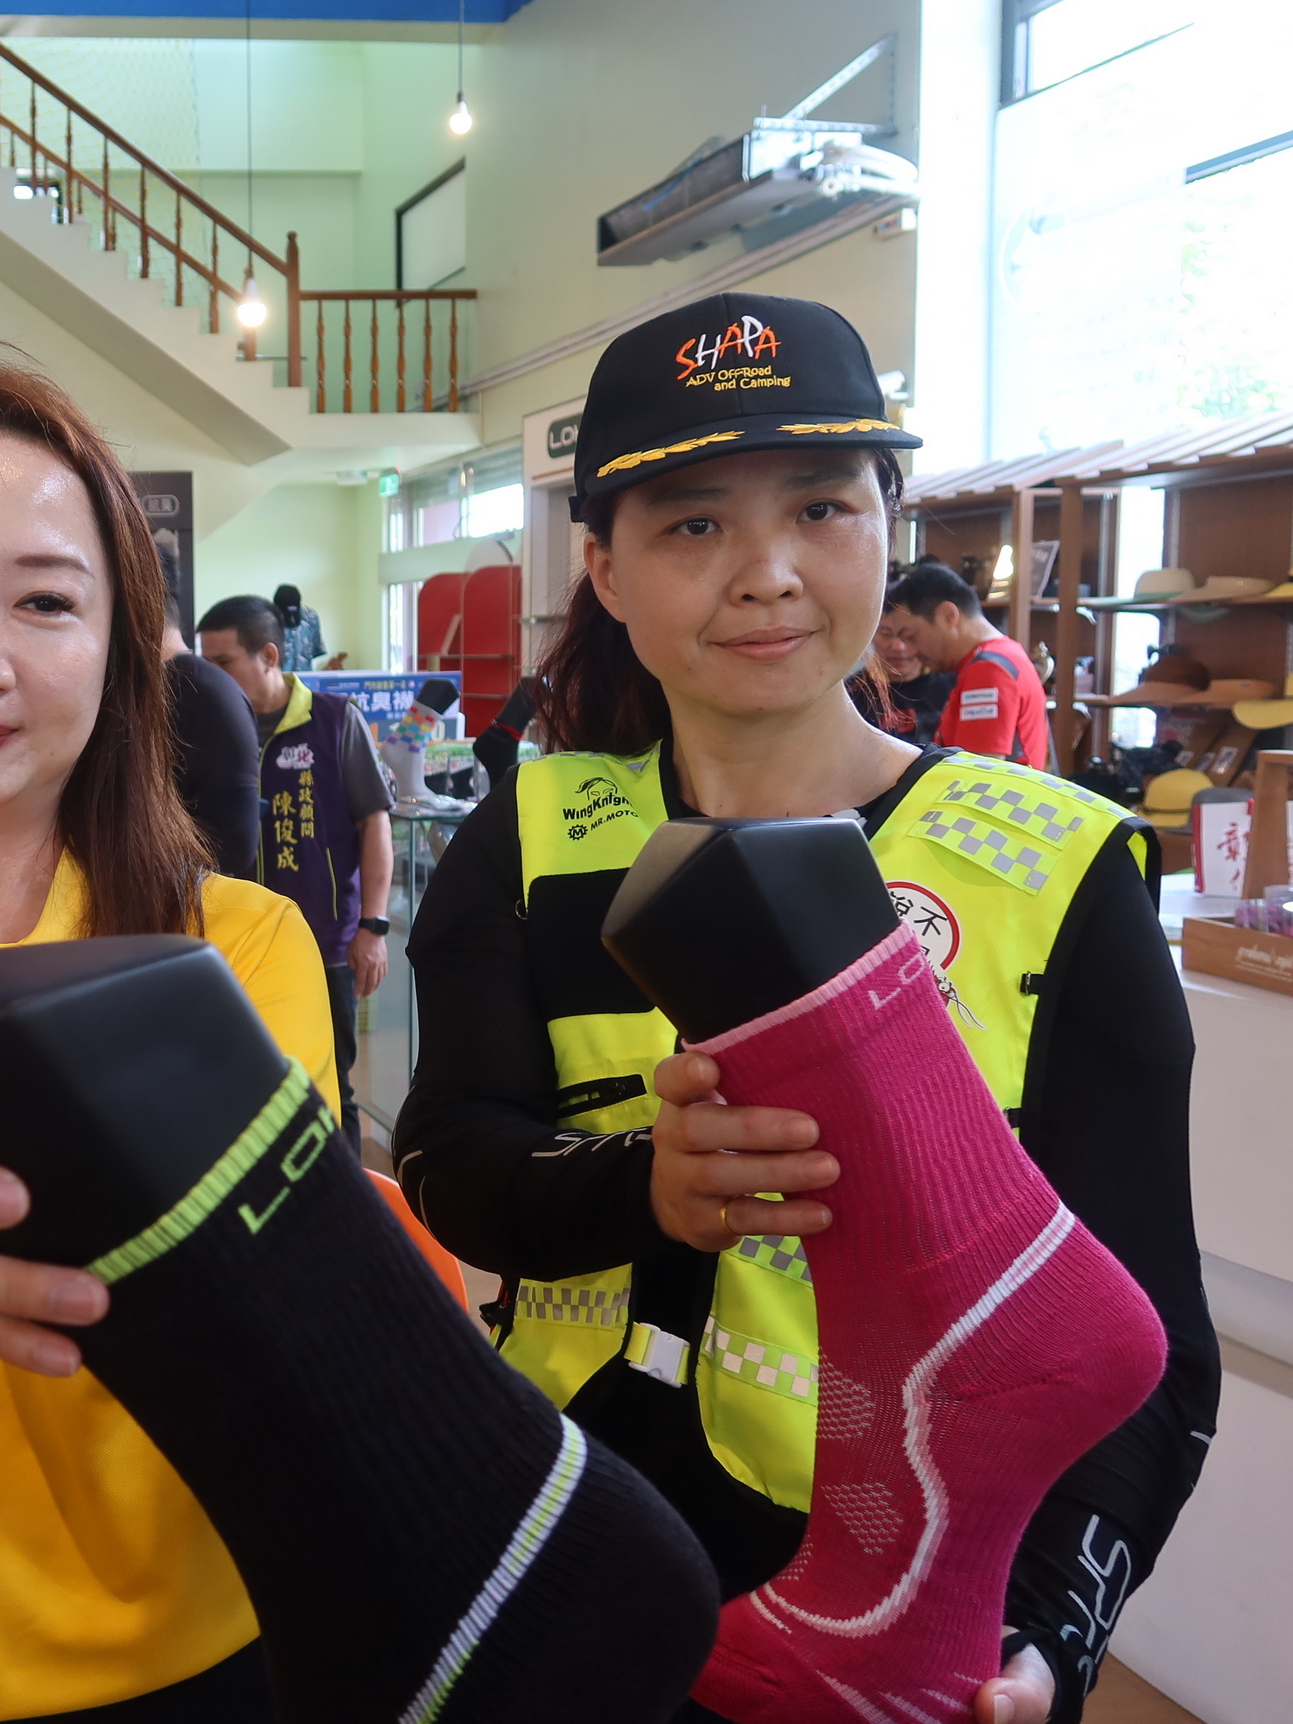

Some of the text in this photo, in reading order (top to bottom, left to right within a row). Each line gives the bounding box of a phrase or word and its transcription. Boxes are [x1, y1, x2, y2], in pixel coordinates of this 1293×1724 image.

[675, 315, 782, 379] SHAPA
[685, 371, 715, 387] ADV
[714, 375, 791, 391] and Camping
[868, 952, 926, 1010] LO
